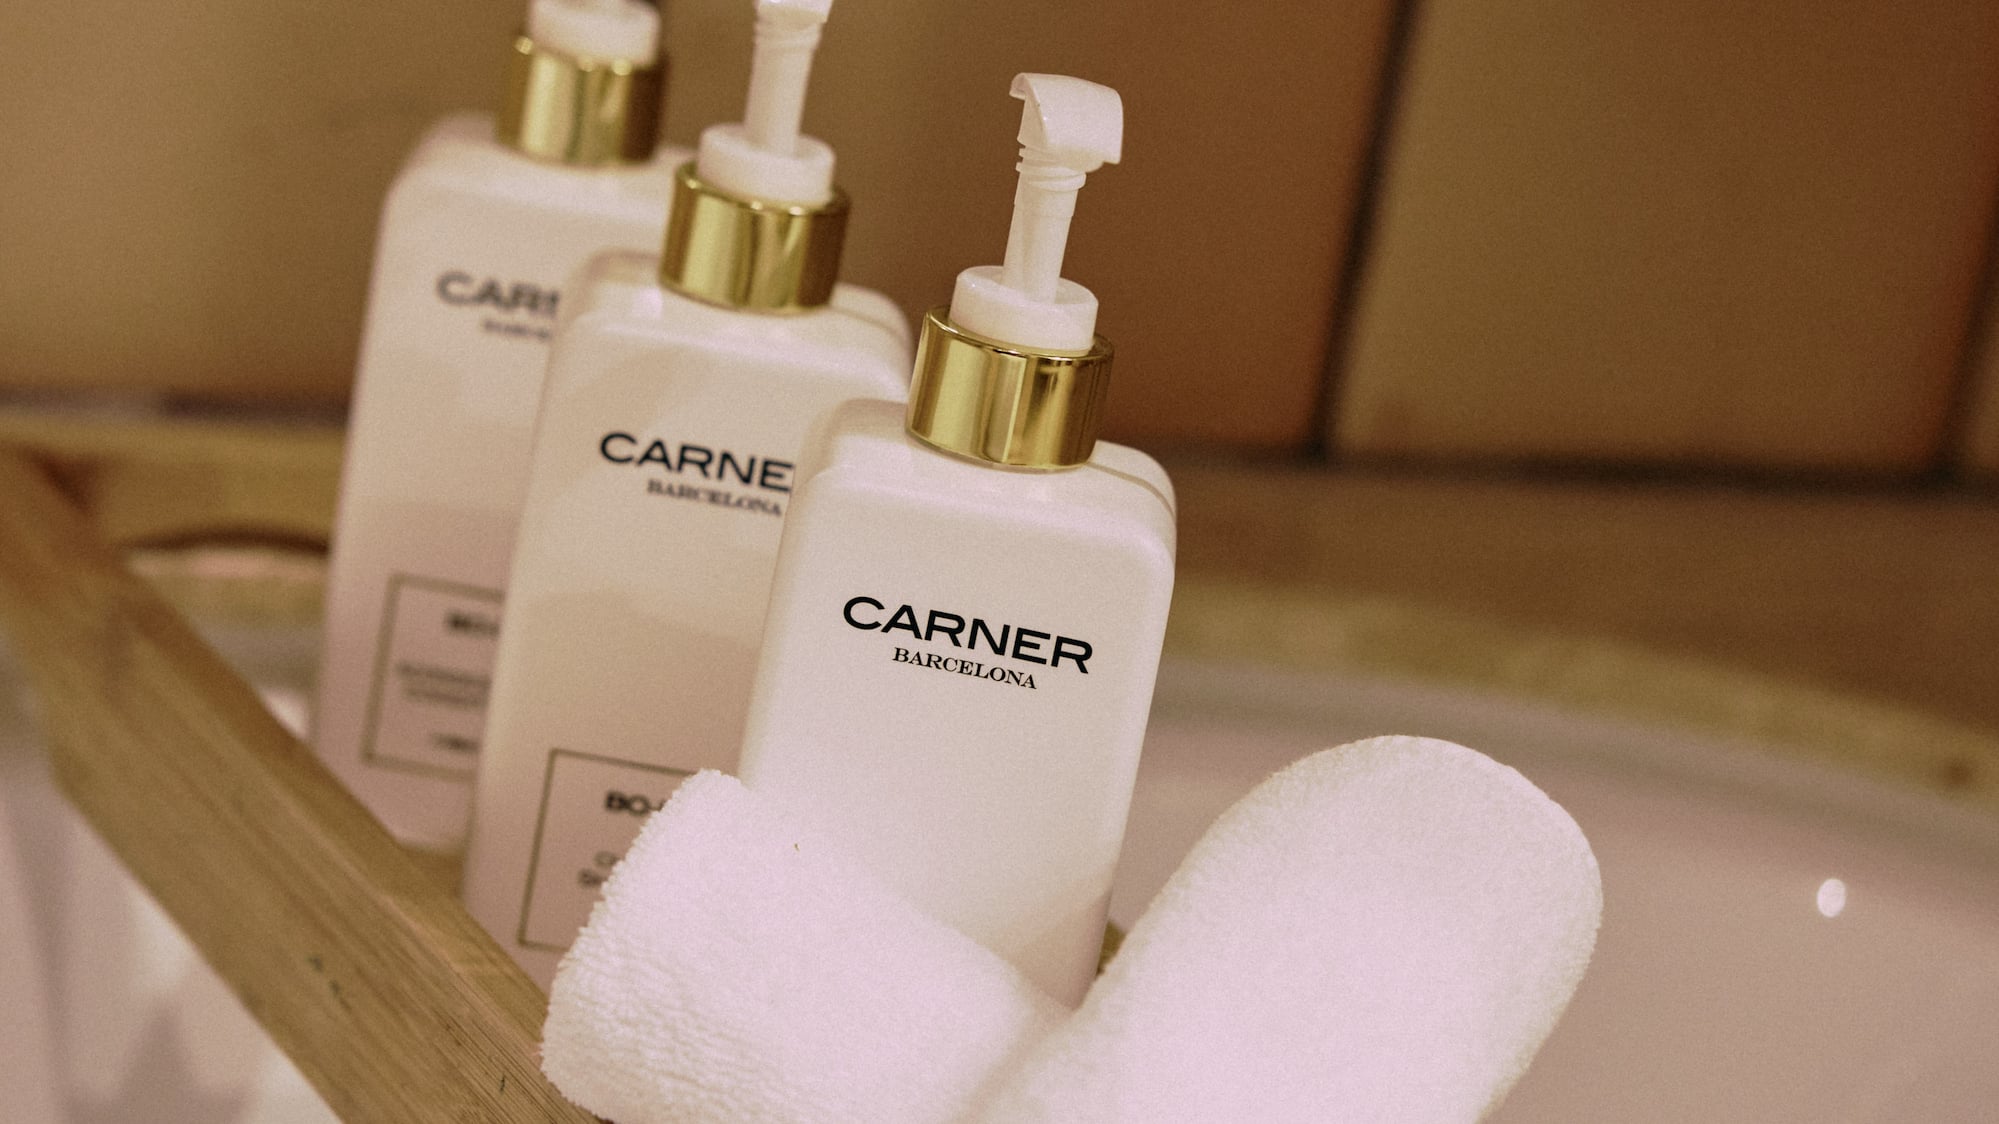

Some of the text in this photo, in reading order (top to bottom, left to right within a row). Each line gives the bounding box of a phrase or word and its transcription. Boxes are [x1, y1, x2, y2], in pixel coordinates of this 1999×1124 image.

[601, 431, 795, 493] CARNE
[648, 478, 781, 517] BARCELONA
[843, 596, 1093, 674] CARNER
[892, 647, 1037, 690] BARCELONA
